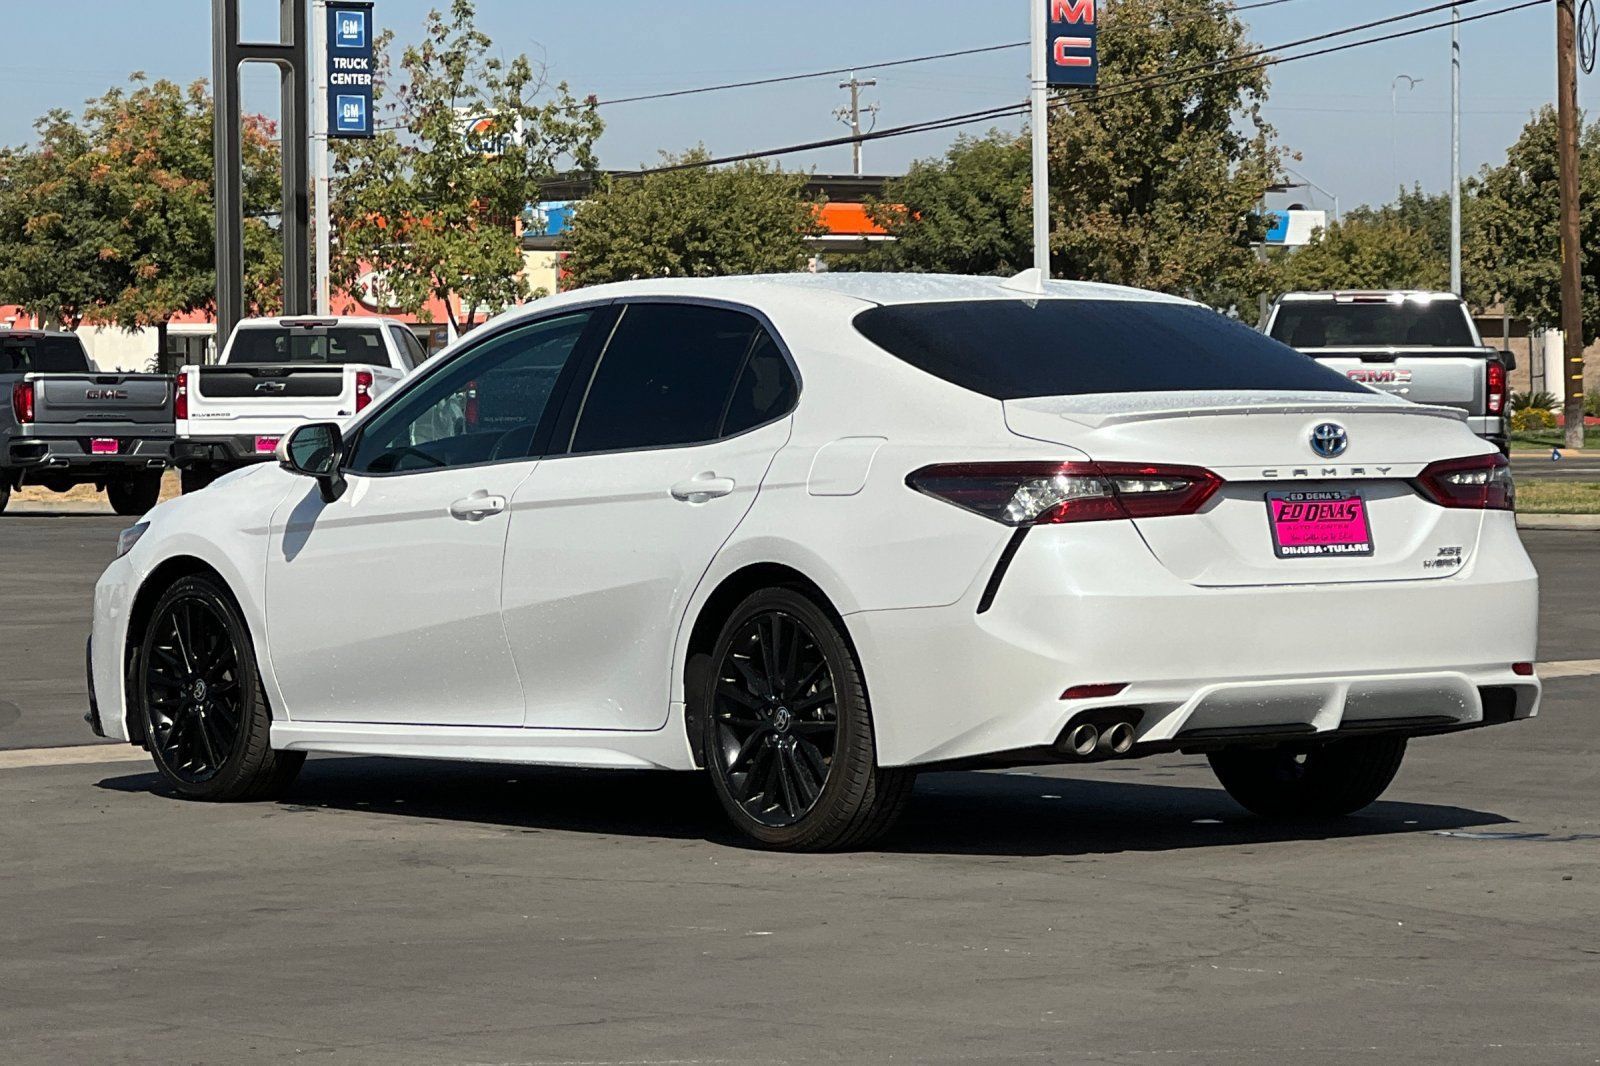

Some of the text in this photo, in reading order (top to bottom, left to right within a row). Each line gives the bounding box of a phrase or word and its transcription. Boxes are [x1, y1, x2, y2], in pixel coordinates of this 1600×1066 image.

[342, 20, 358, 34] GM
[333, 57, 368, 69] TRUCK
[330, 73, 372, 85] CENTER
[343, 104, 359, 118] GM
[1346, 369, 1412, 385] GMC
[86, 389, 129, 400] GMC
[1262, 467, 1392, 478] CAMRY
[1306, 492, 1340, 500] DENA'S
[1276, 504, 1304, 523] ED
[1327, 543, 1370, 553] TULARE
